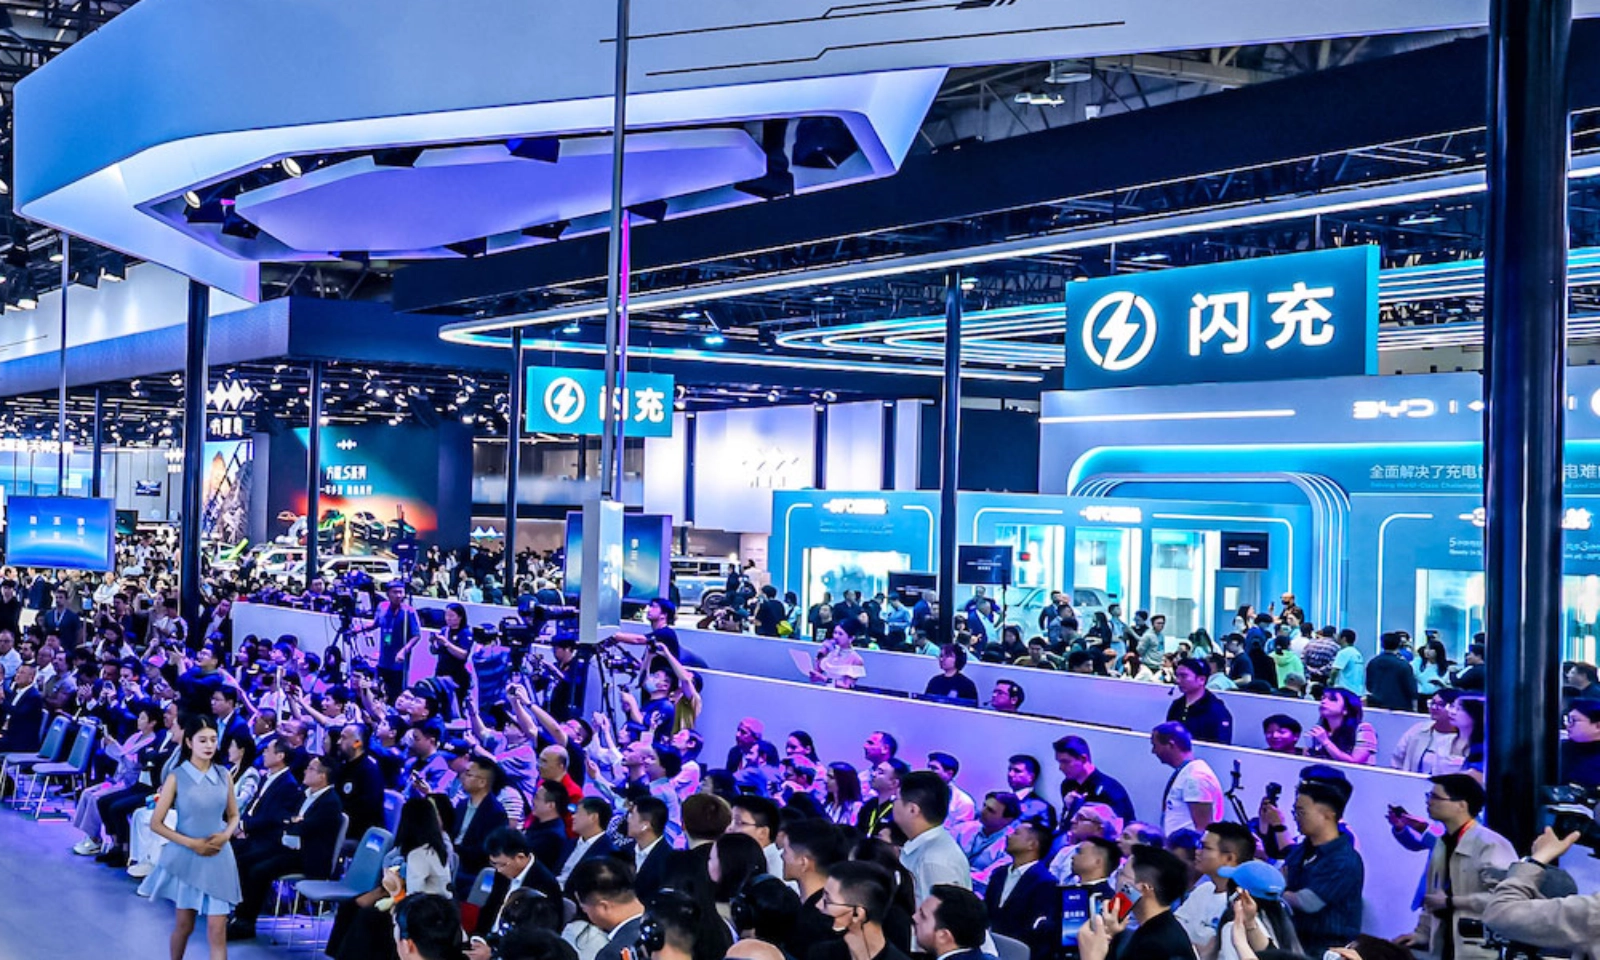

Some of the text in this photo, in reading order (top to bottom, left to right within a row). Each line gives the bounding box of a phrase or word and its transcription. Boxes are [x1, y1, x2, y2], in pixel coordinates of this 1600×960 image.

[1188, 281, 1336, 358] 闪充
[1353, 398, 1435, 420] BYD
[1369, 463, 1600, 479] 全面解决了充电 电难
